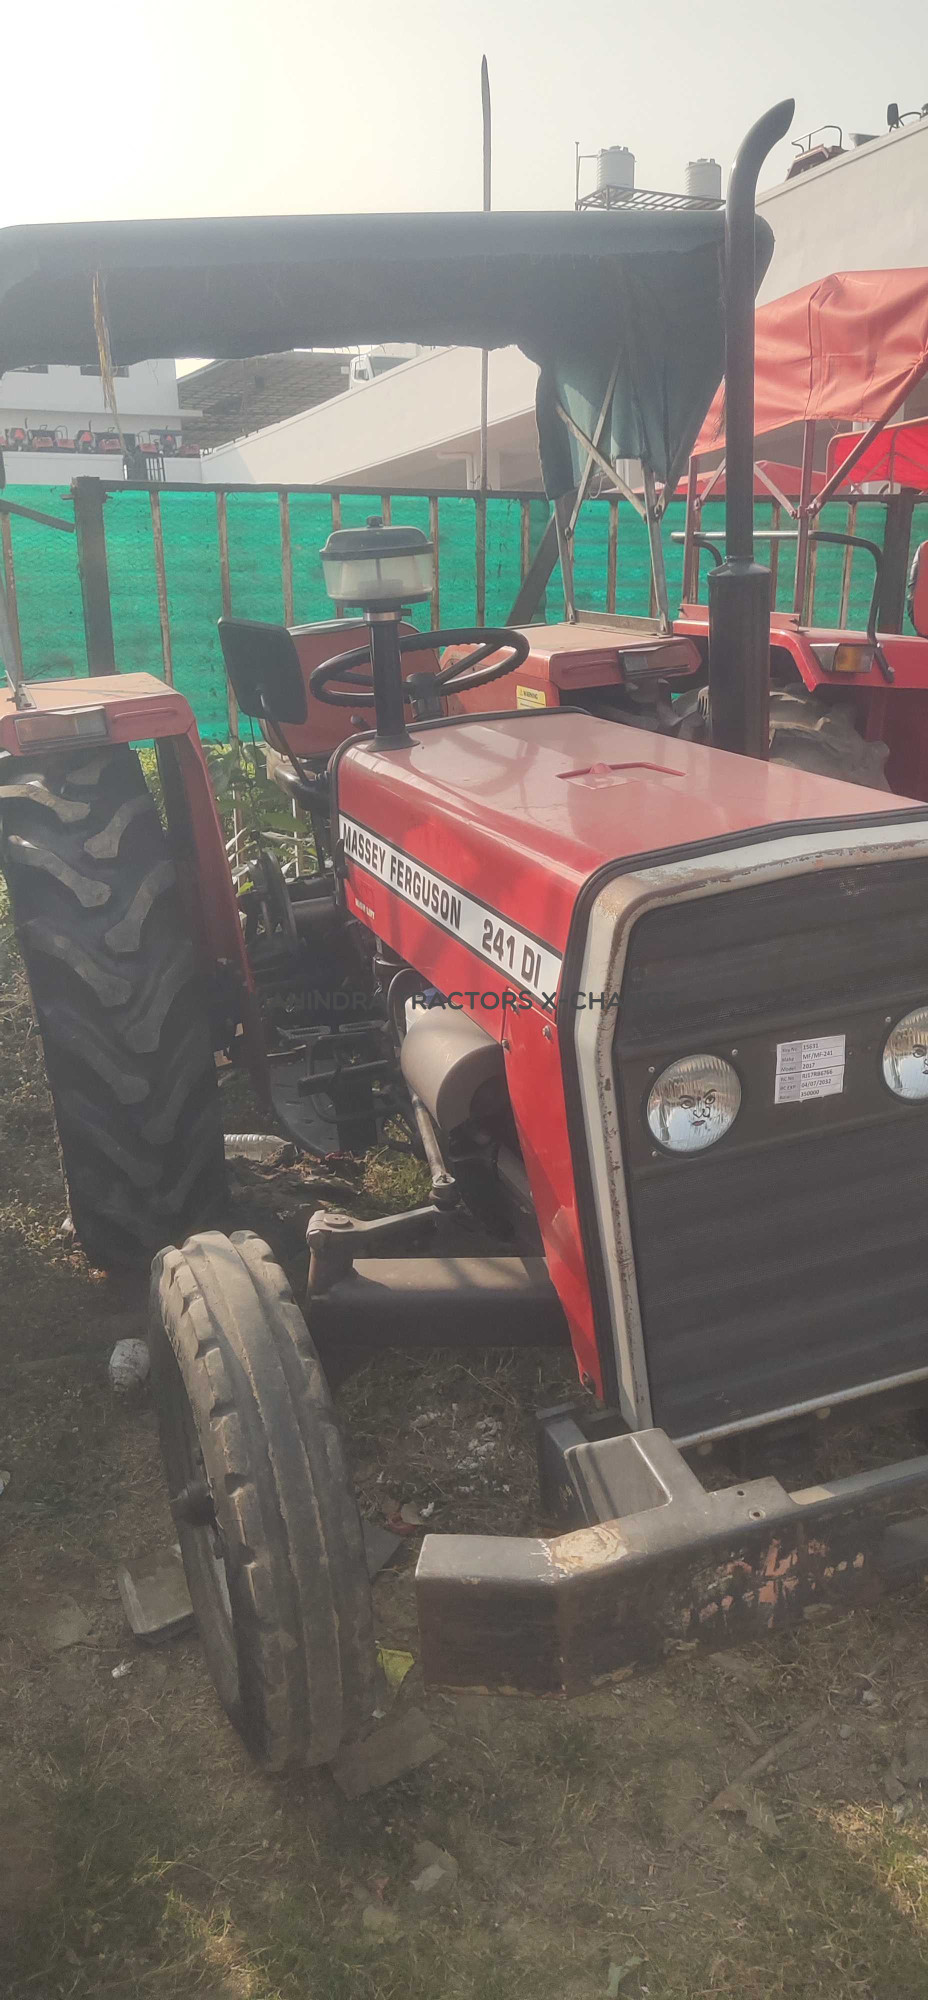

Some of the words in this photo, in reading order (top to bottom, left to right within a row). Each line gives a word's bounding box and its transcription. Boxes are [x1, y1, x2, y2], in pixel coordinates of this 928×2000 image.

[343, 823, 386, 874] MASSEY
[390, 855, 462, 930] FERGUSON
[482, 918, 515, 970] 241
[521, 948, 542, 988] DI
[802, 1051, 833, 1059] MF/MF-241
[801, 1079, 831, 1087] 04/07/2032
